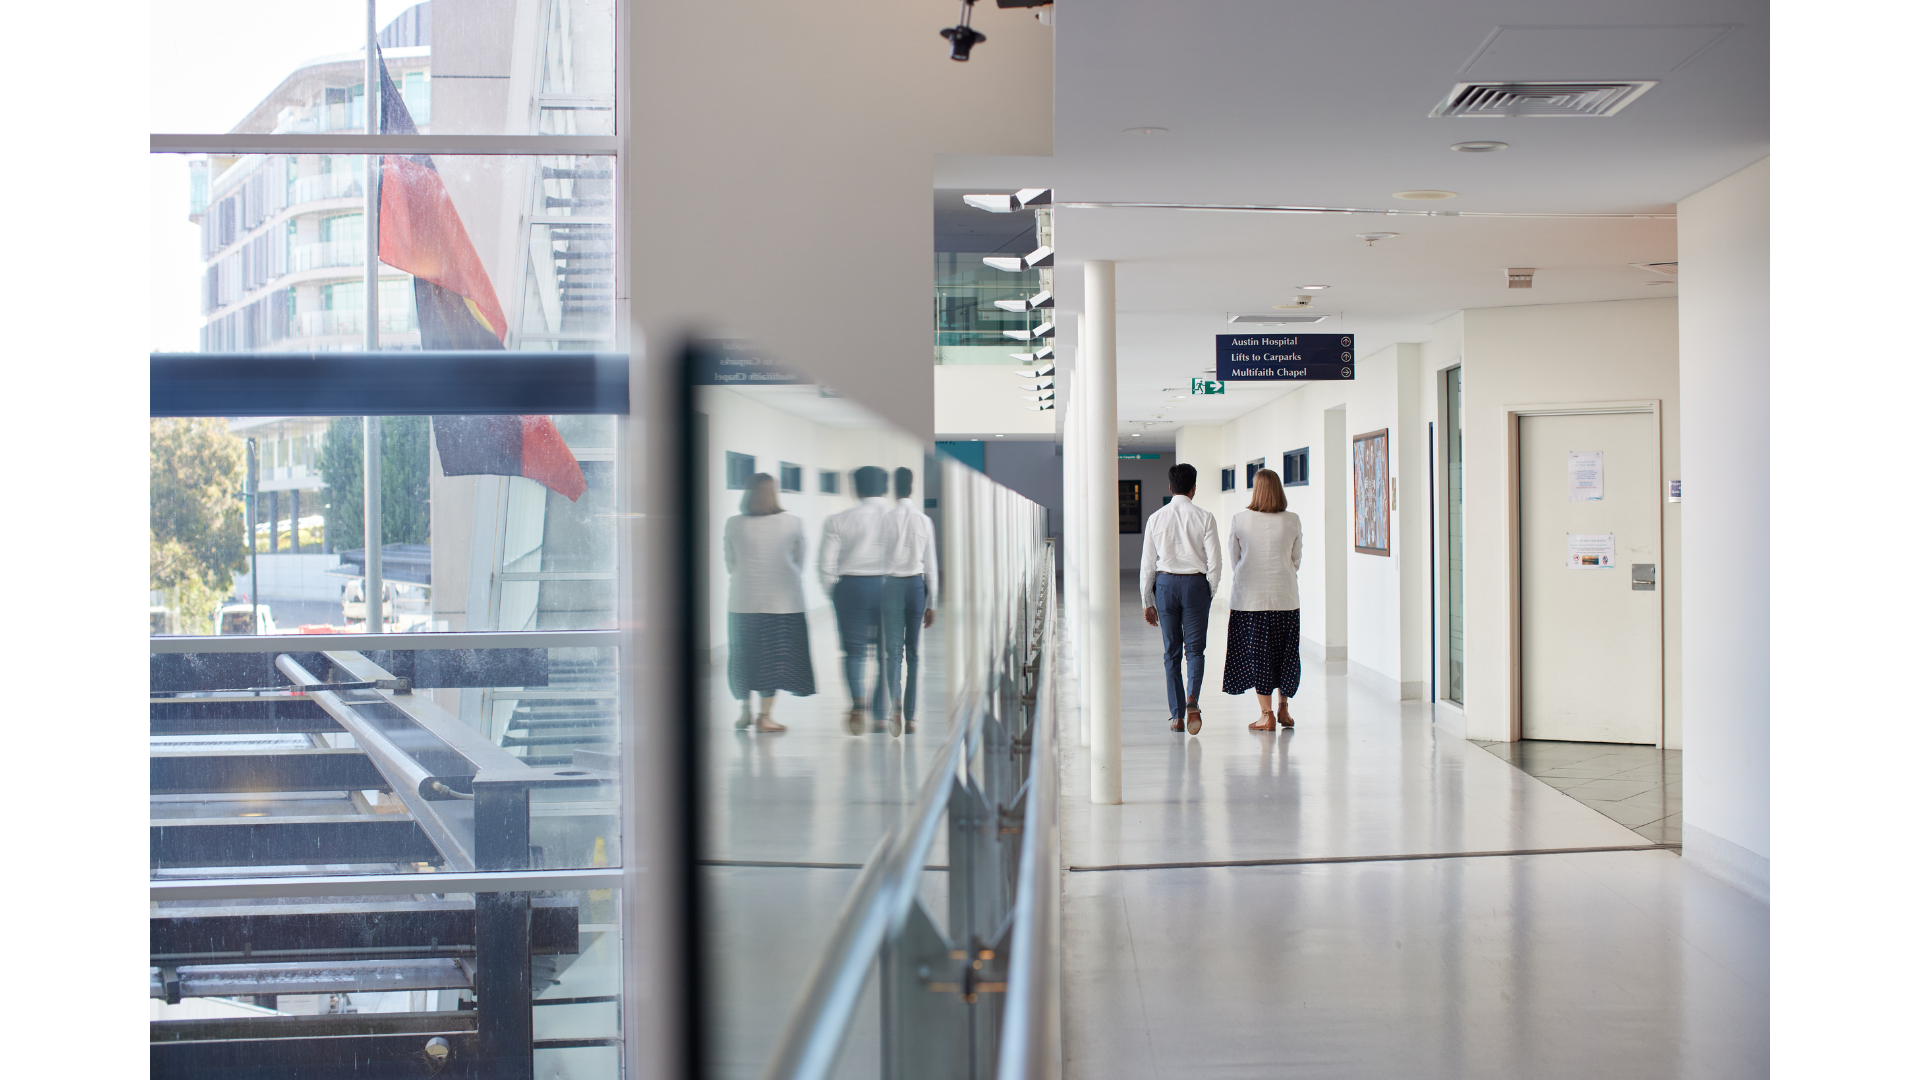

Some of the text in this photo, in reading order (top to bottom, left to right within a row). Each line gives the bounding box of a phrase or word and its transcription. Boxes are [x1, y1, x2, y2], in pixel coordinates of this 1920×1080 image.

[1231, 336, 1298, 347] Austin Hospital
[1231, 352, 1302, 363] Lifts to Carparks
[1231, 367, 1307, 378] Multifaith Chapel
